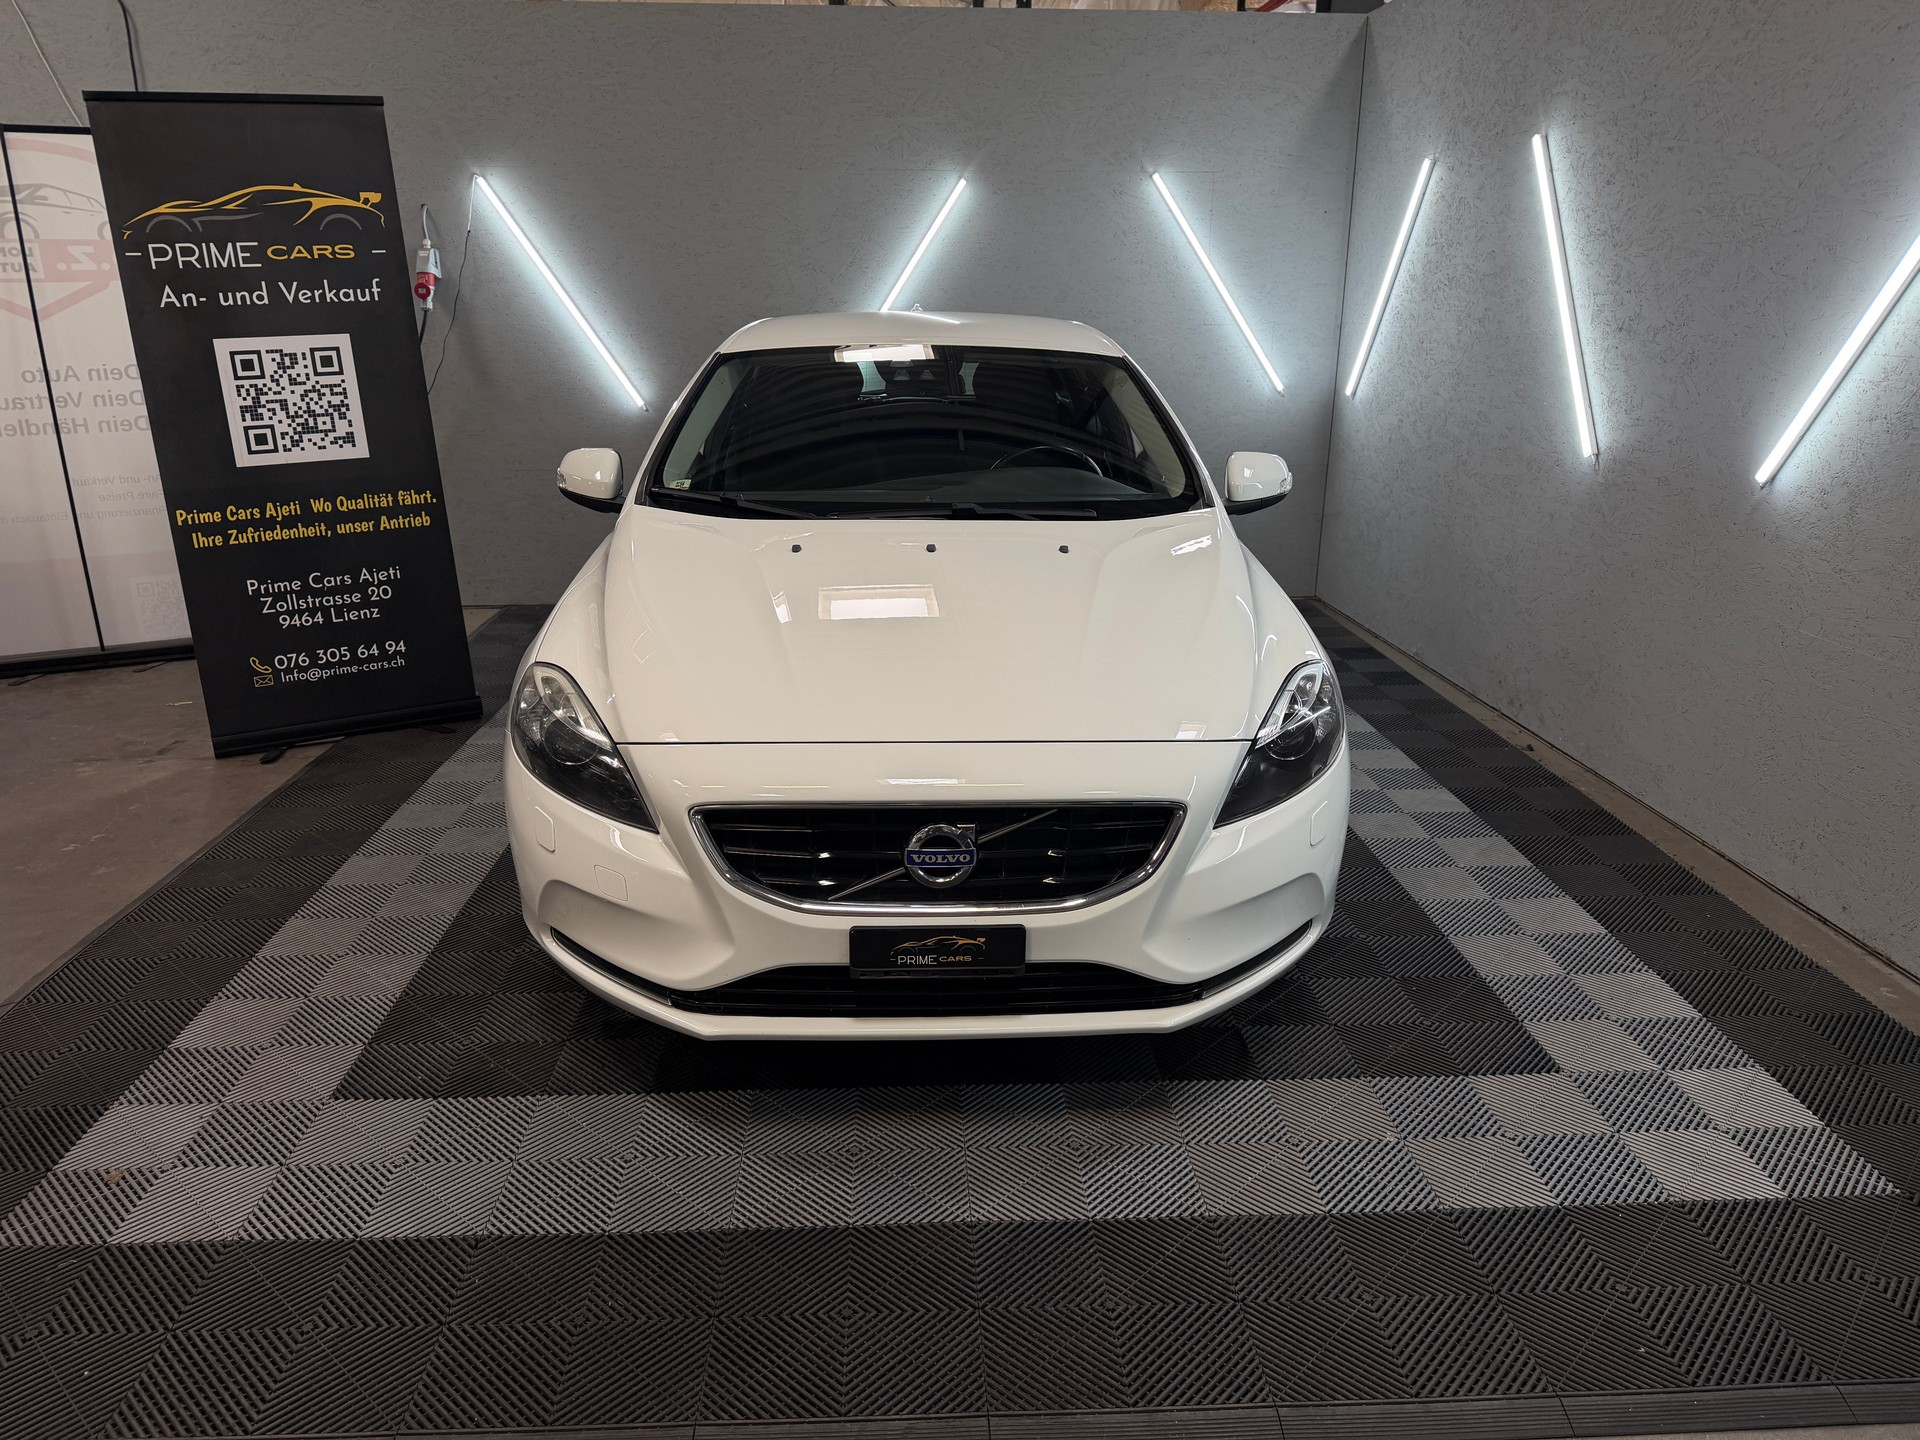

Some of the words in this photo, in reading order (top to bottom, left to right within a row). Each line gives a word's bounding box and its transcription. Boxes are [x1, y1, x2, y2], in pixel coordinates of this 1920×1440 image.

[147, 242, 262, 269] PRIME
[266, 244, 356, 260] CARS
[160, 284, 207, 308] An-
[218, 281, 269, 306] und
[278, 278, 381, 305] Verkauf
[175, 508, 222, 526] Prime
[226, 504, 261, 522] Cars
[265, 501, 301, 523] Ajeti
[310, 498, 332, 513] Wo
[336, 493, 394, 512] Qualität
[397, 489, 437, 505] fährt.
[191, 532, 223, 549] Ihre
[227, 522, 332, 545] Zufriedenheit,
[336, 519, 375, 535] unser
[379, 511, 431, 531] Antrieb
[246, 579, 302, 596] Prime
[308, 572, 352, 588] Cars
[359, 565, 401, 585] Ajeti
[260, 592, 361, 614] Zollstrasse
[368, 585, 392, 601] 20
[278, 611, 324, 629] 9464
[330, 607, 381, 623] Lienz
[274, 652, 310, 669] 076
[316, 646, 350, 664] 305
[357, 643, 380, 658] 64
[385, 639, 406, 655] 94
[280, 655, 405, 682] Info@prime-cars.ch
[910, 853, 971, 863] VOLVO
[897, 954, 938, 965] PRIME
